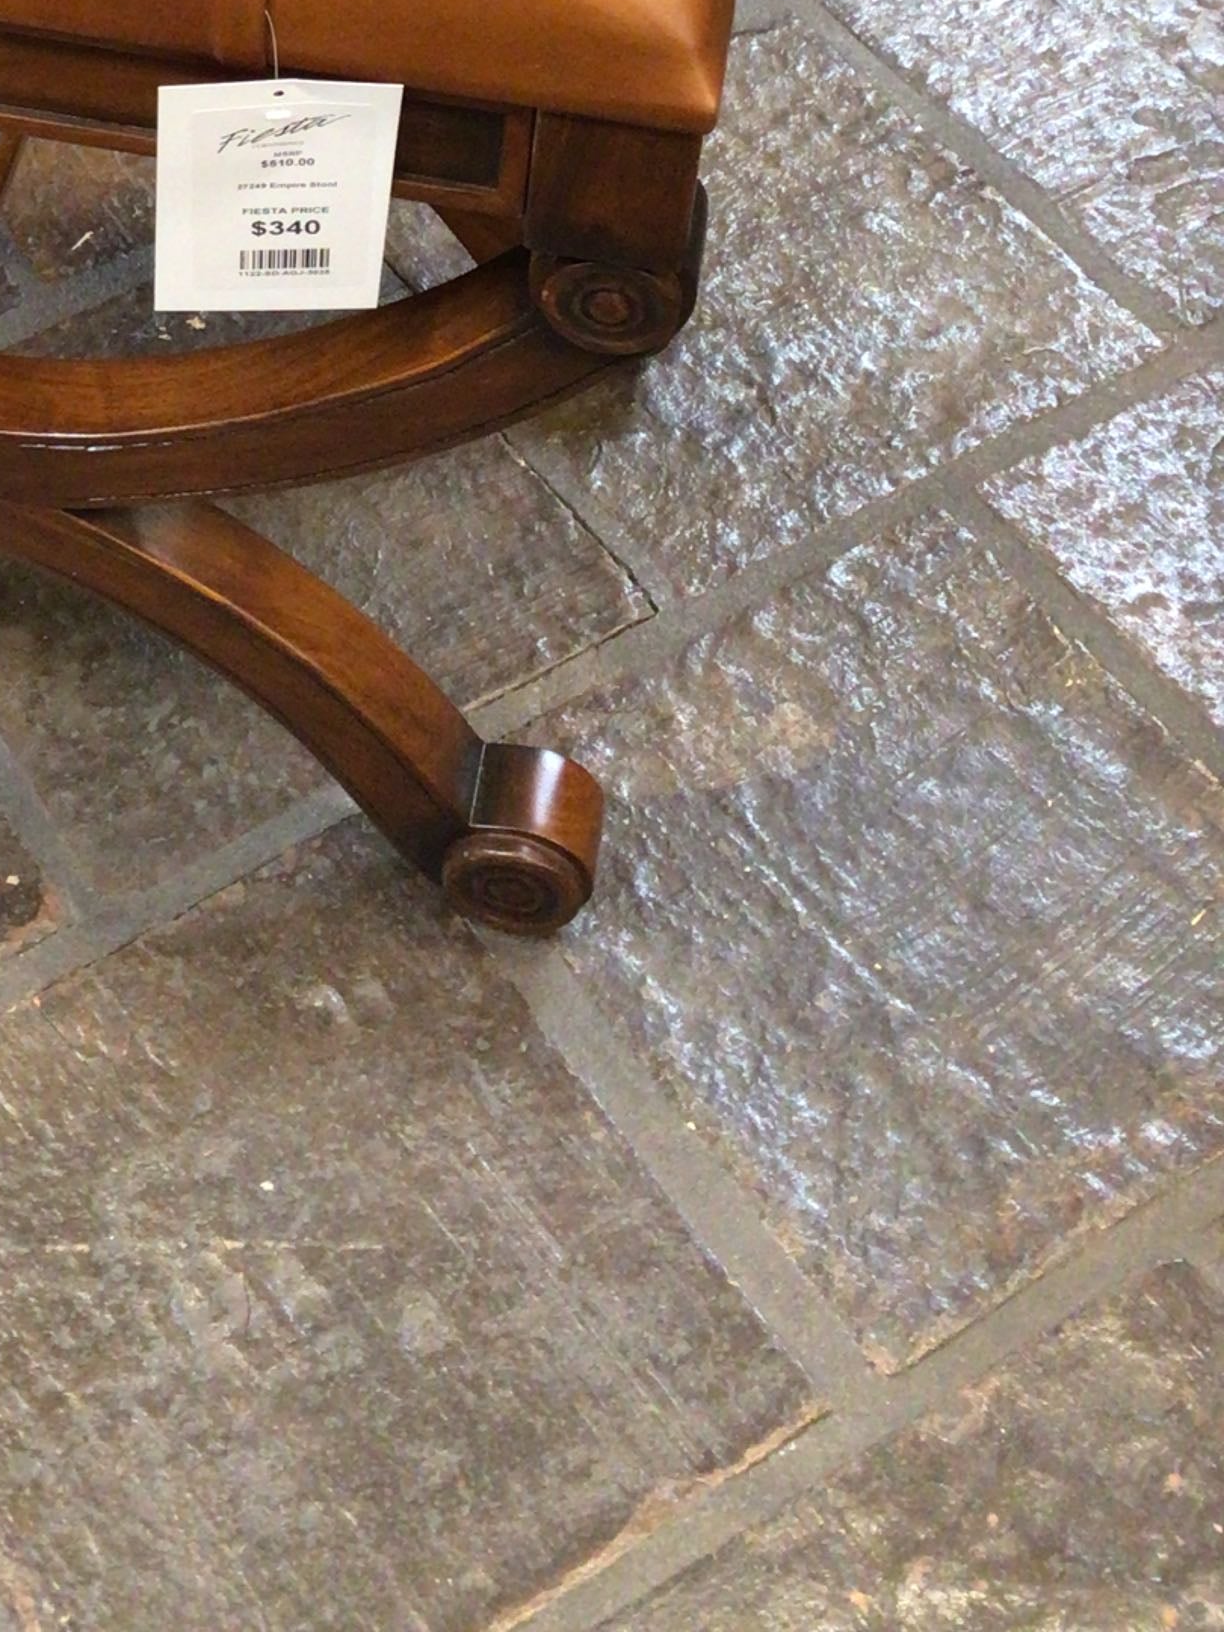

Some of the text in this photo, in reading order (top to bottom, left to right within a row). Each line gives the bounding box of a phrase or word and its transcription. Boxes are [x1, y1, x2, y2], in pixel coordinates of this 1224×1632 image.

[217, 113, 352, 154] Fiesta
[242, 206, 330, 215] FIESTA PRICE
[251, 220, 321, 237] $340
